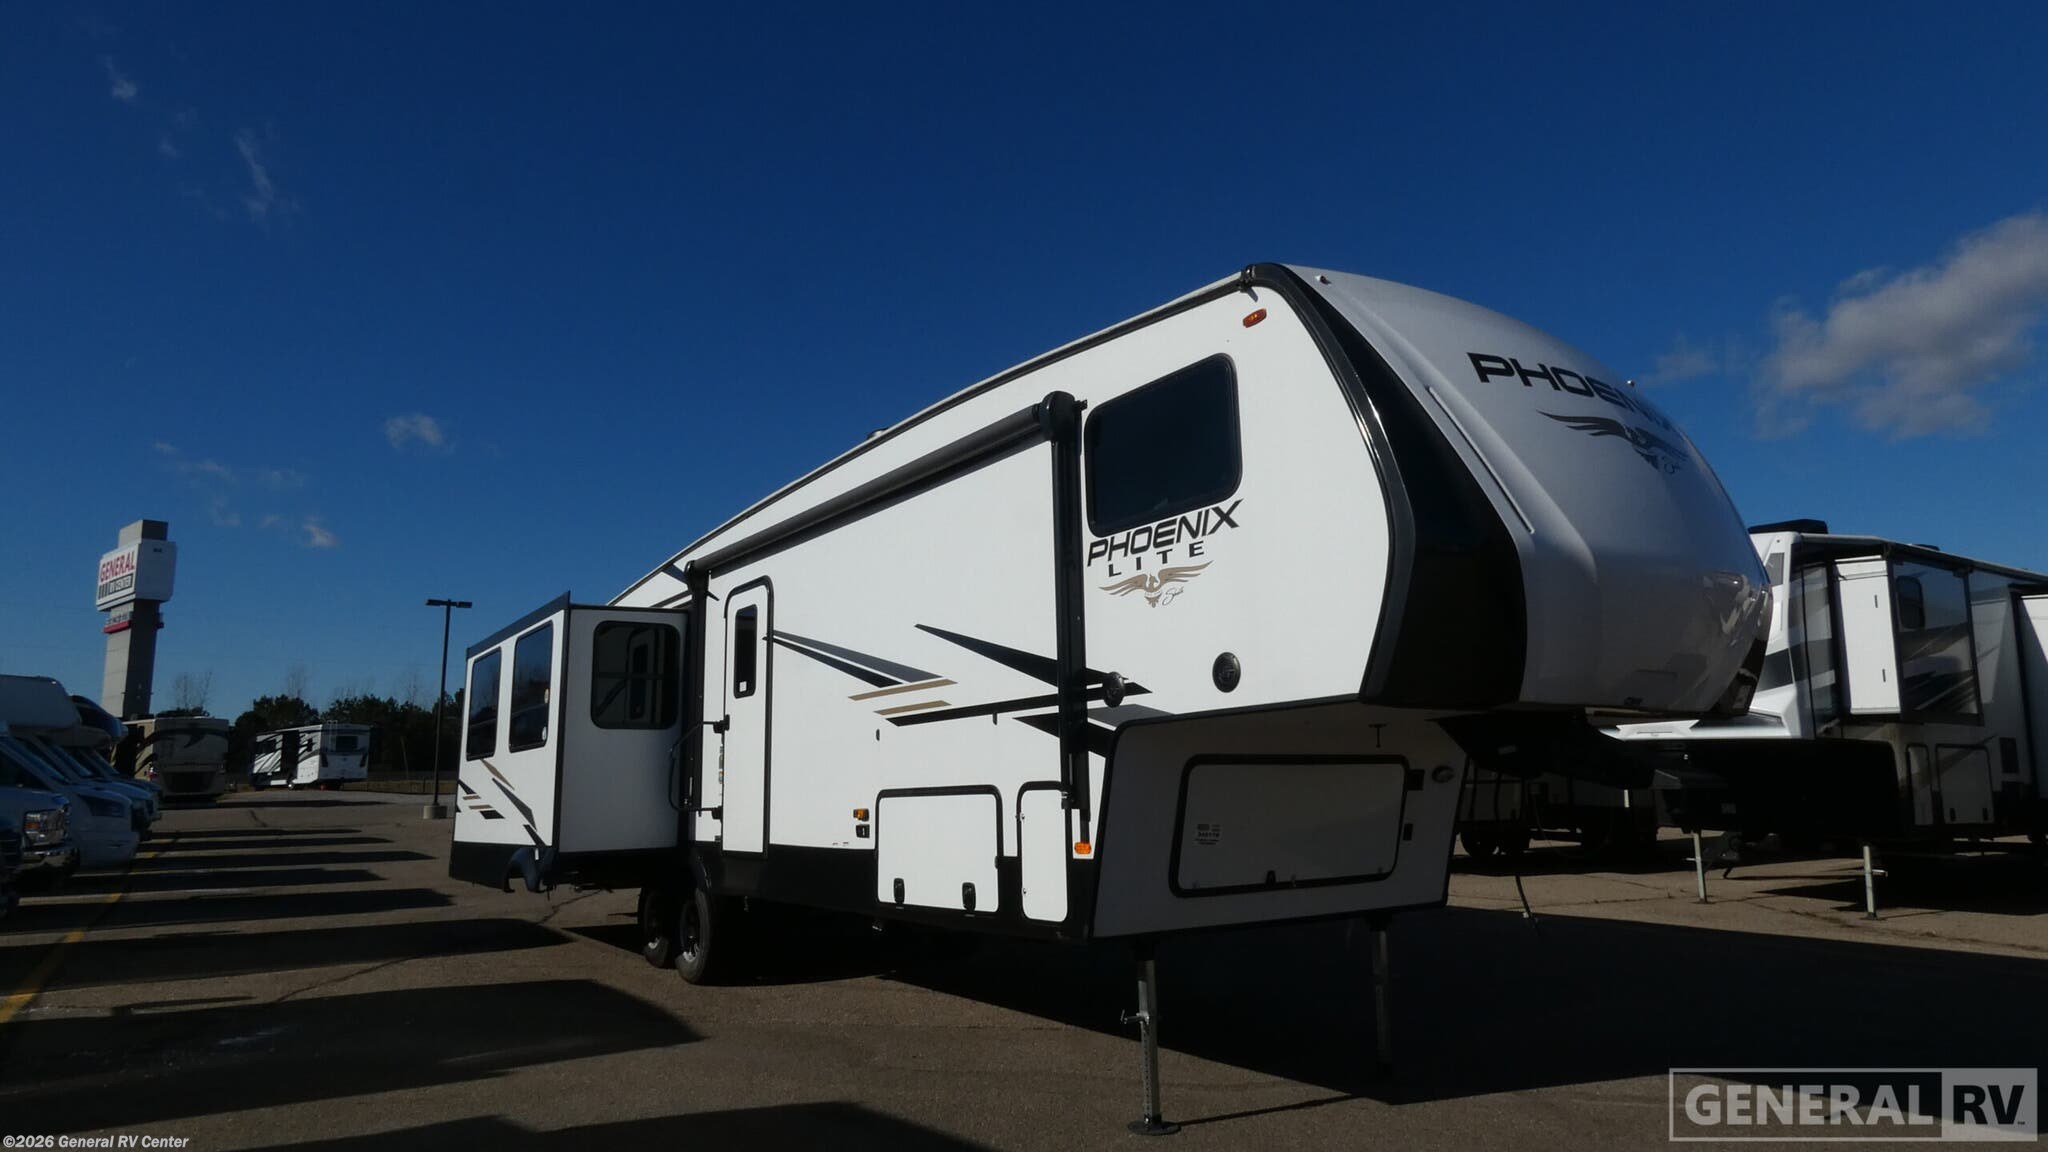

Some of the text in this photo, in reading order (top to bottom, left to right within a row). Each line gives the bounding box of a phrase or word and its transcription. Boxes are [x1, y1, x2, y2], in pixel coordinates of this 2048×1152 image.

[1087, 498, 1244, 567] PHOENIX
[100, 551, 135, 582] GENERAL
[1108, 540, 1205, 577] LITE
